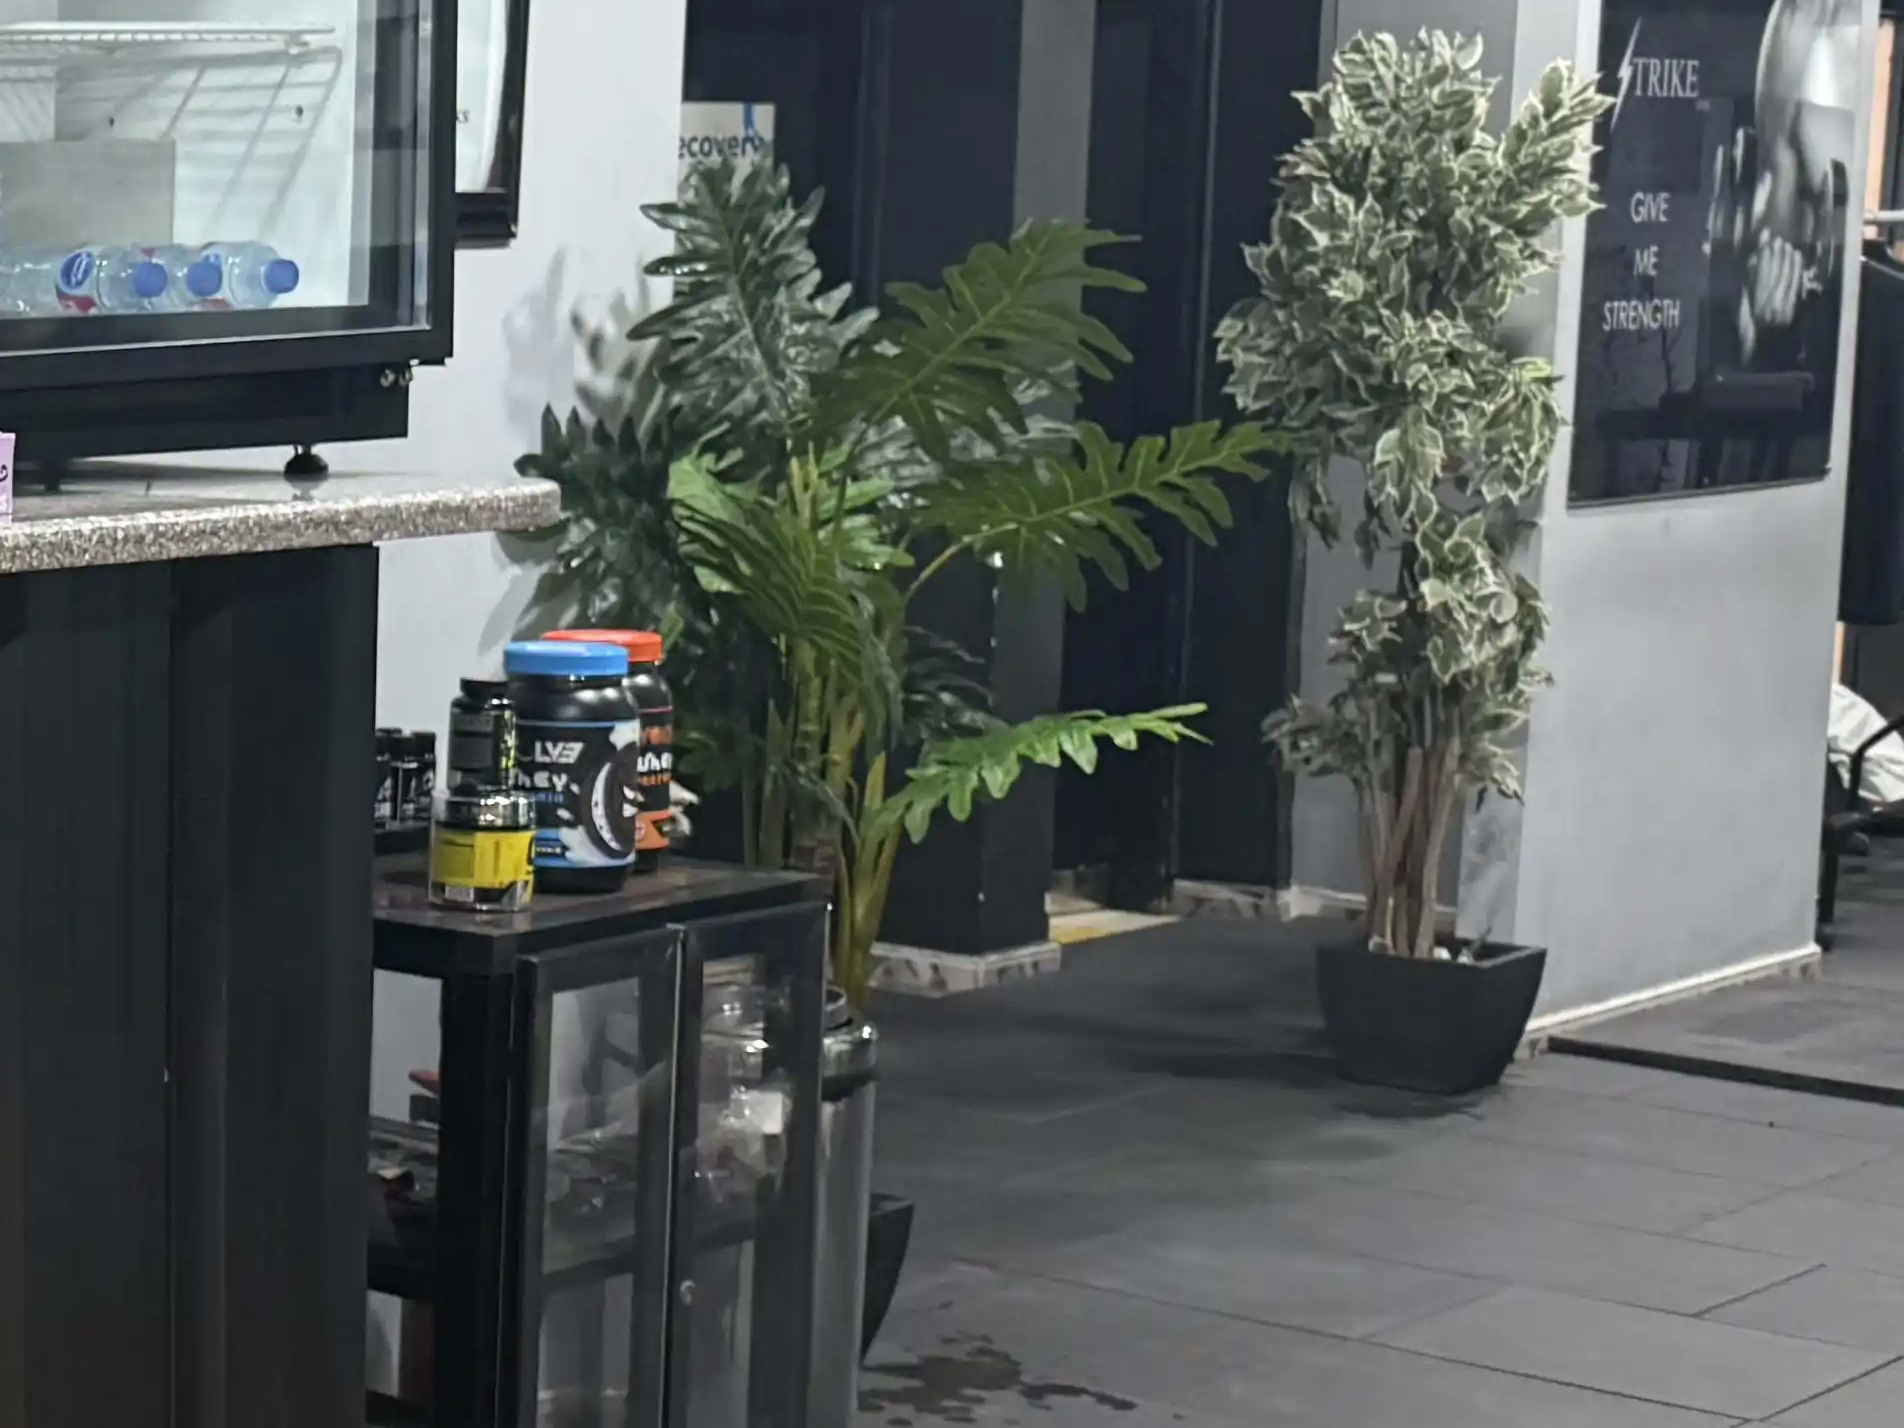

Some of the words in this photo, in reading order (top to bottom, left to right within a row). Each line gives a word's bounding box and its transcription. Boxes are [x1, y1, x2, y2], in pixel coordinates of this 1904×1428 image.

[1630, 192, 1669, 222] GIVE
[1633, 246, 1659, 276] ME
[1602, 300, 1680, 331] STRENGTH
